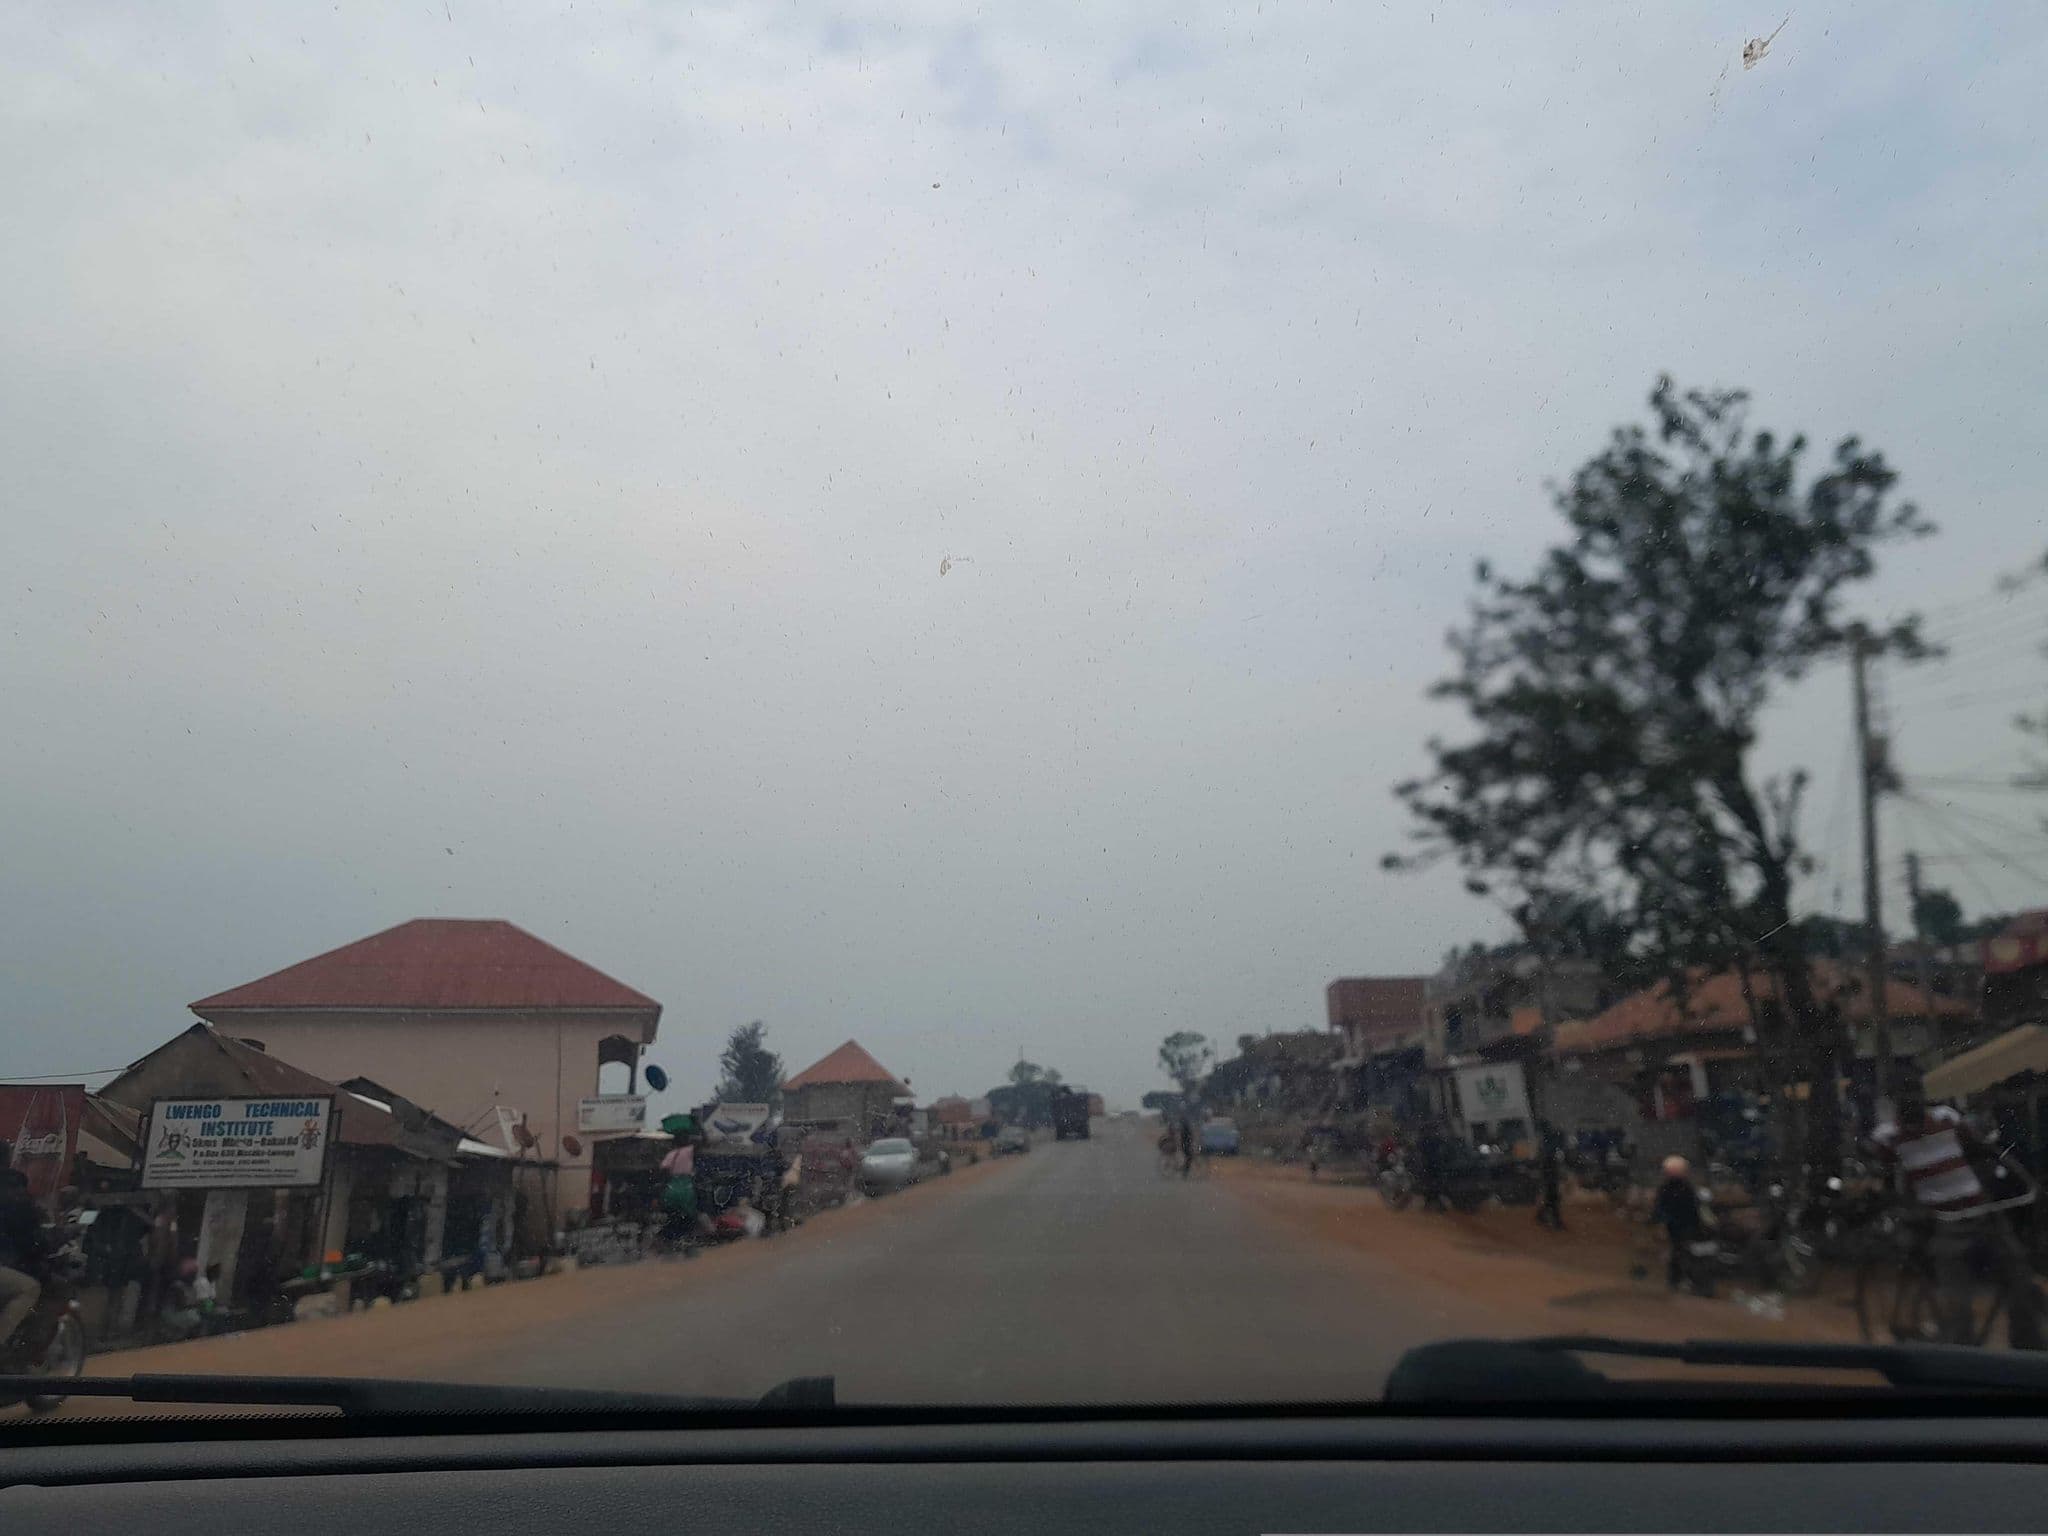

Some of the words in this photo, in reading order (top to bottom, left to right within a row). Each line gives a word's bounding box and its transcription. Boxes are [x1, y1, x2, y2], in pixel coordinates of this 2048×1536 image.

[165, 1104, 222, 1119] LWENGO
[244, 1102, 320, 1118] TECHNICAL
[200, 1121, 275, 1136] INSTITUTE
